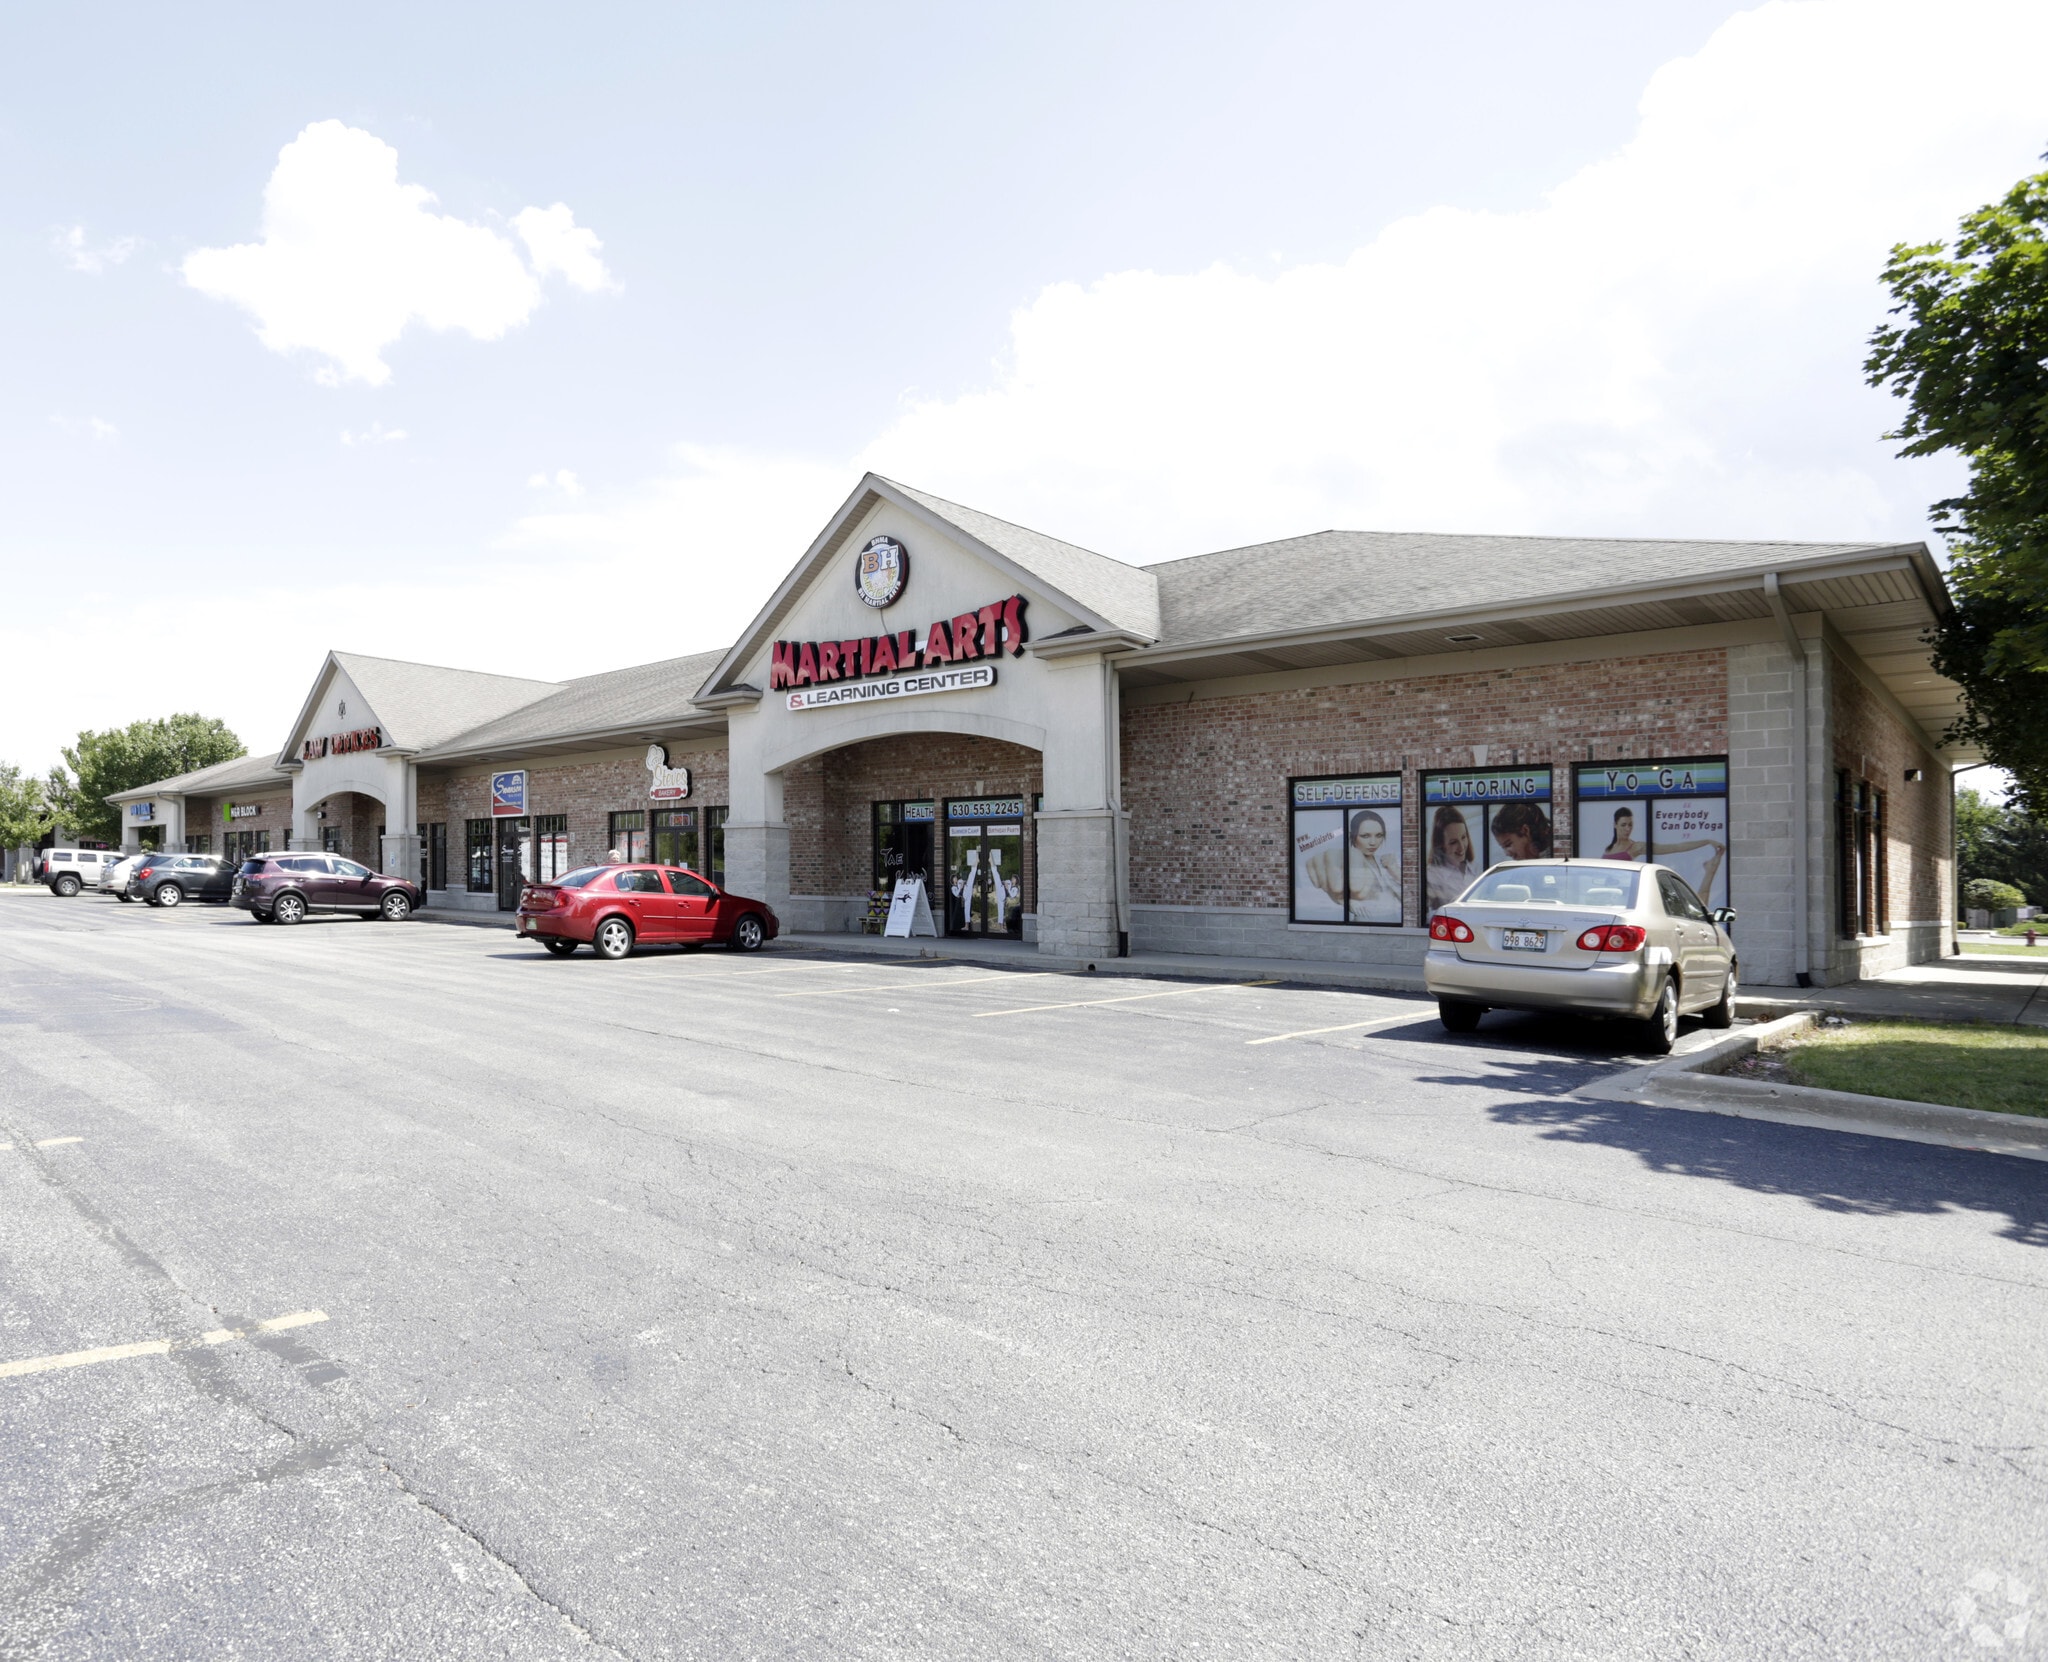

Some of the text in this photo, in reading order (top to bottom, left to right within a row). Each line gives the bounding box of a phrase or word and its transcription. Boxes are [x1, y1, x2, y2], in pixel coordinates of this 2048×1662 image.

[863, 596, 889, 607] MARTIAL
[770, 594, 1024, 690] MARTIAL ARTS
[789, 668, 989, 709] & LEARNING CENTER
[1296, 783, 1398, 802] SELF-DEFENSE
[1439, 778, 1535, 798] TUTORING
[241, 805, 257, 817] BLOCK
[905, 806, 935, 818] HEALTH
[952, 802, 1020, 817] 630 553 2245
[1655, 810, 1709, 820] Everybody
[1661, 821, 1724, 831] Can Do Yoga
[1504, 935, 1544, 948] 998 8629
